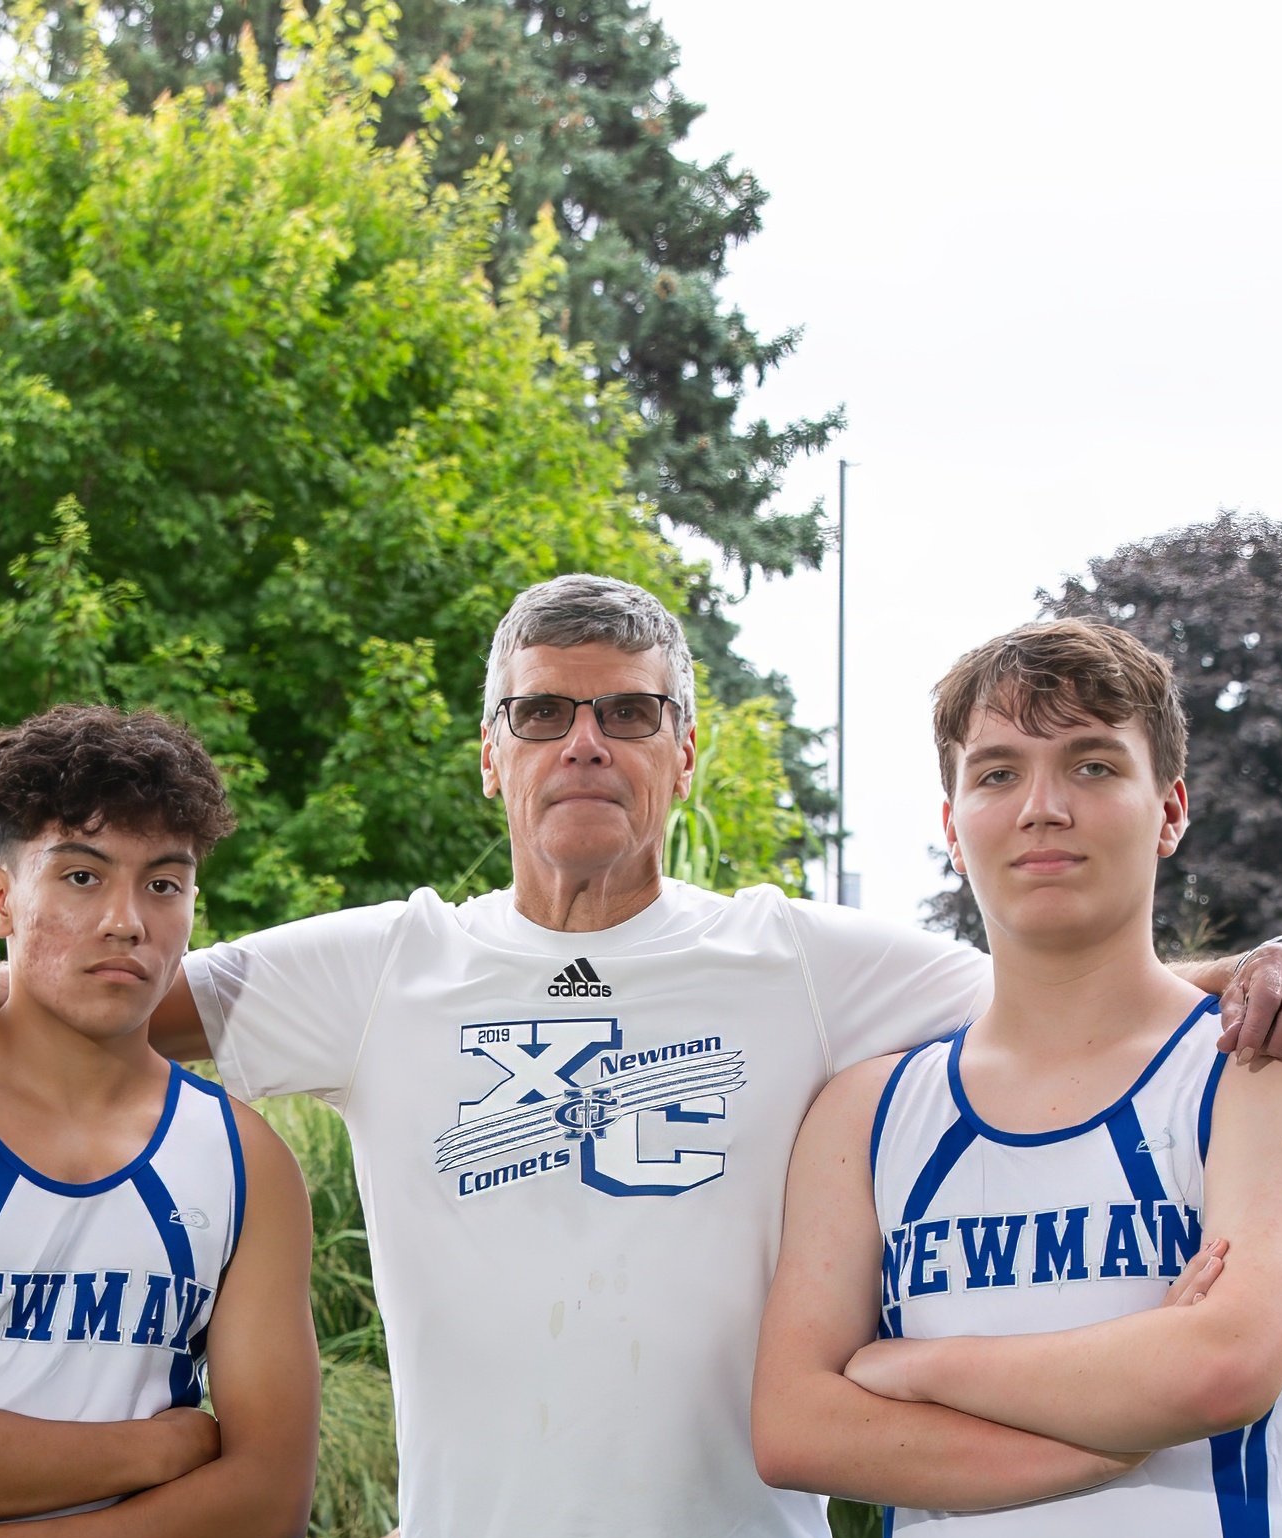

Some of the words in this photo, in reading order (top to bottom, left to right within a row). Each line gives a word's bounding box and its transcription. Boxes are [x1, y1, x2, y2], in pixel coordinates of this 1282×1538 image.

[547, 981, 612, 998] adidas
[477, 1028, 510, 1044] 2019
[599, 1035, 721, 1079] Newman
[458, 1147, 571, 1197] Comets
[881, 1200, 1203, 1310] NEWMAN
